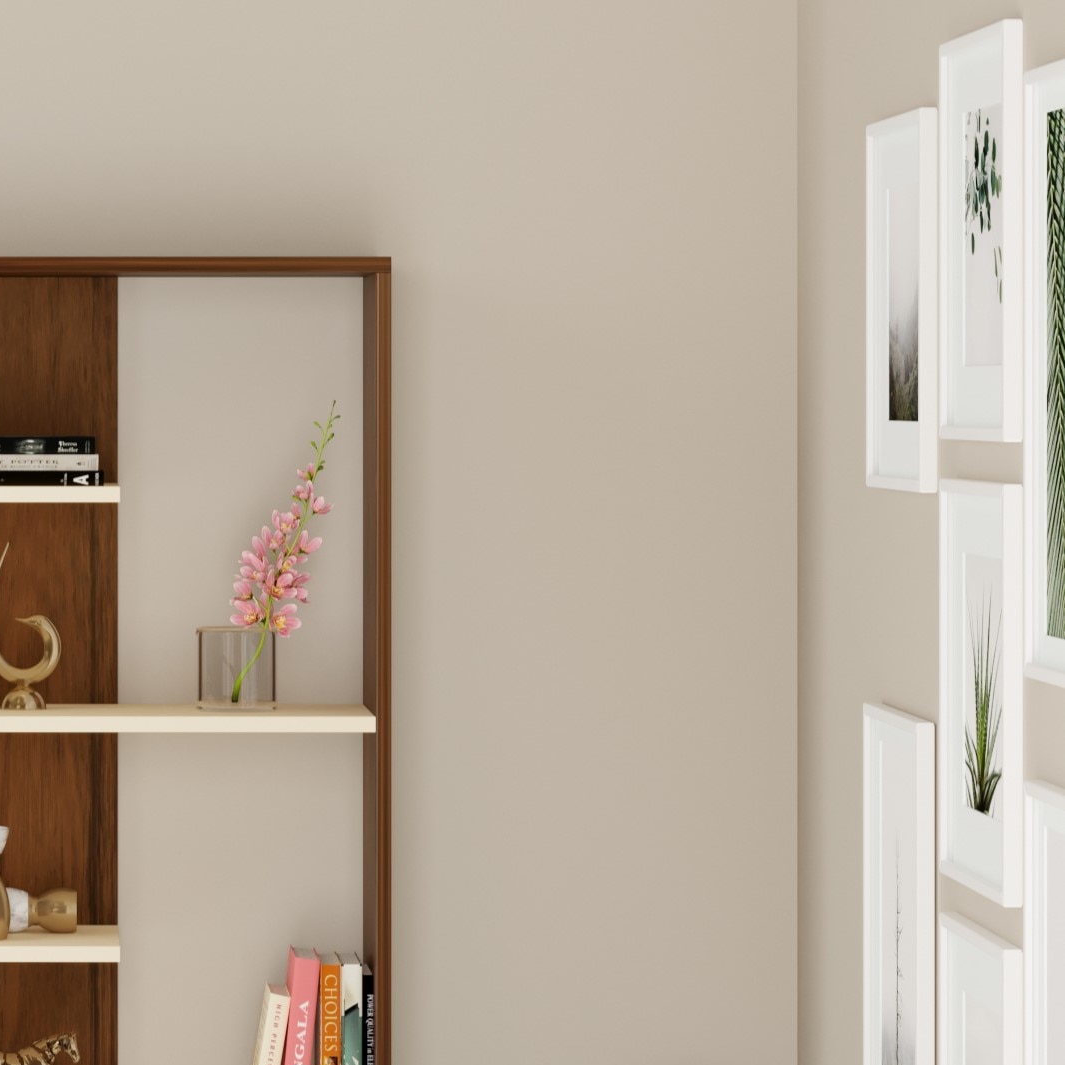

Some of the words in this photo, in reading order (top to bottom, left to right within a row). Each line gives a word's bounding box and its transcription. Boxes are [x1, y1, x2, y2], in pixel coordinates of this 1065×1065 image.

[273, 1004, 282, 1028] HIGH
[325, 974, 337, 1052] CHOICES
[366, 1018, 374, 1047] QUALITY
